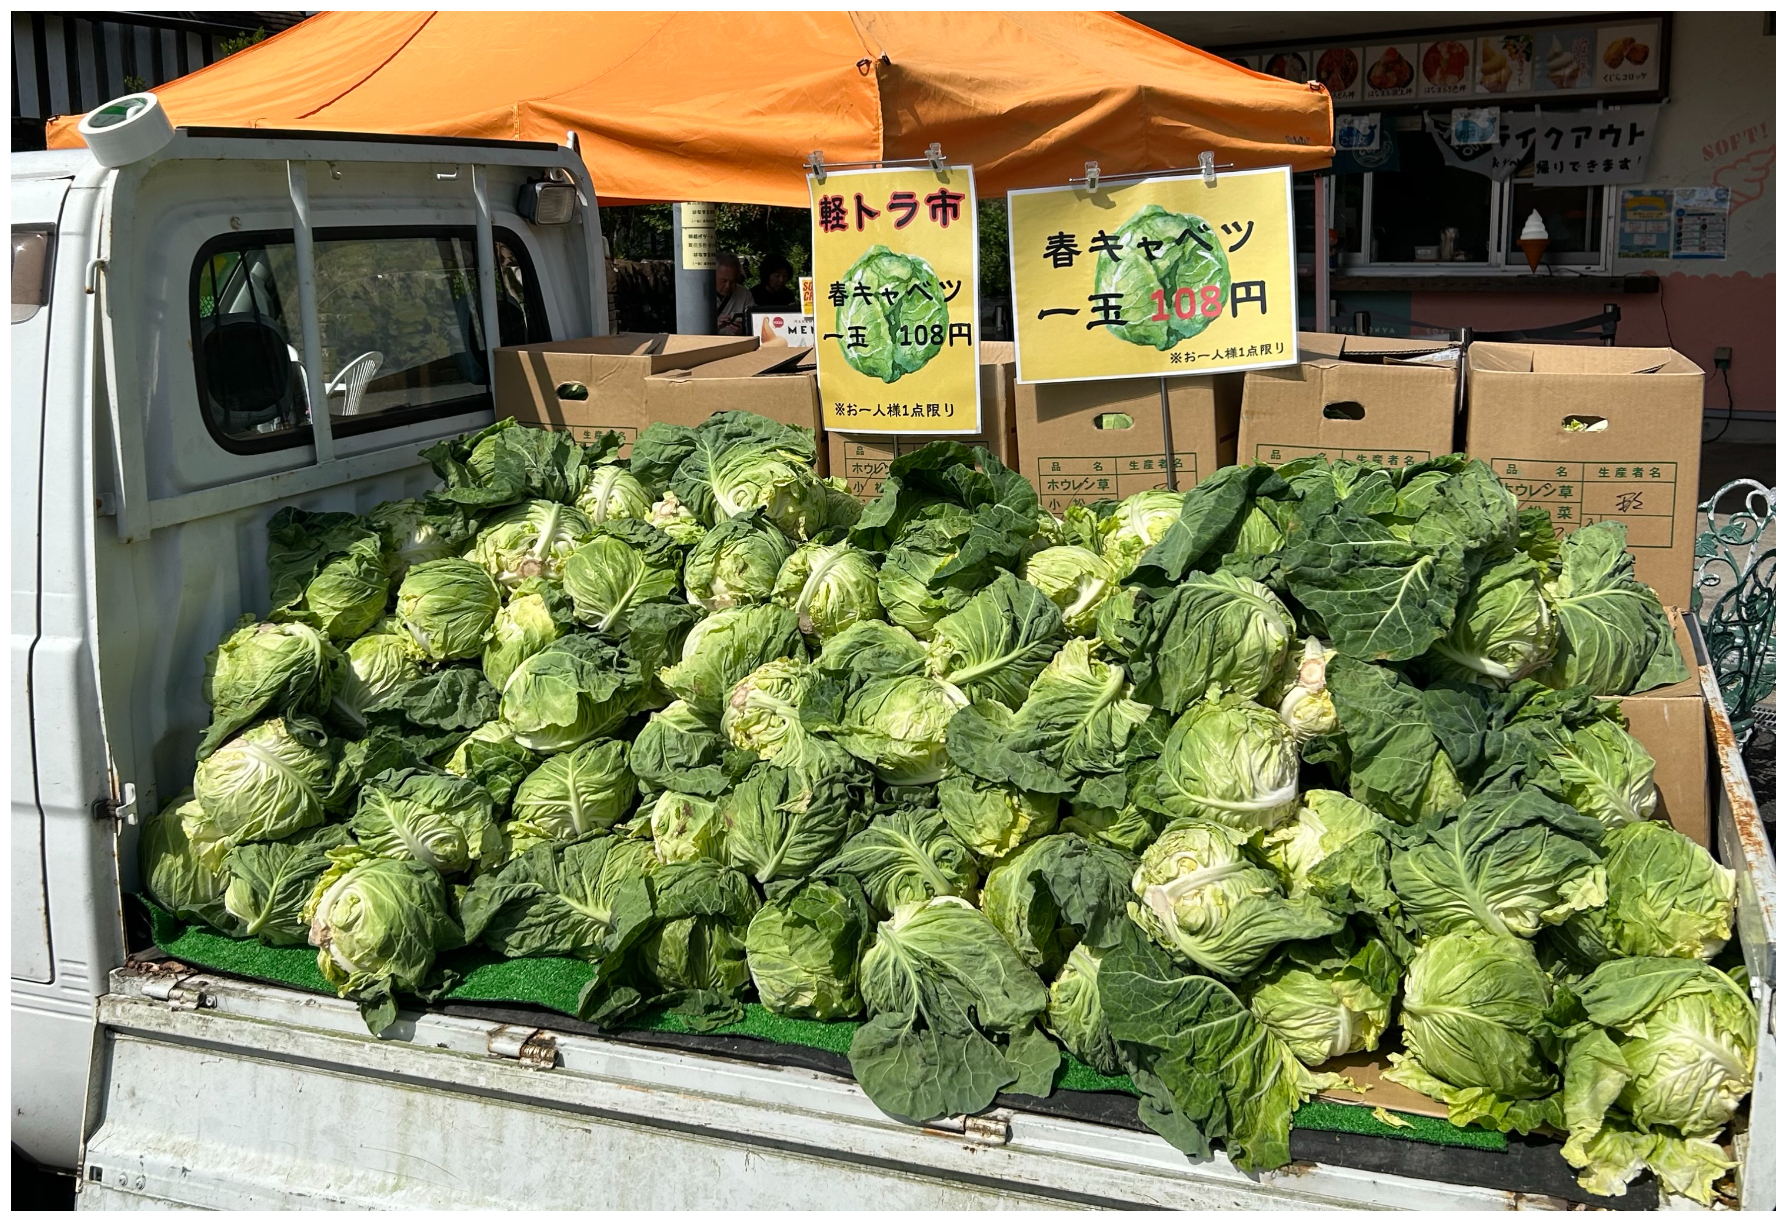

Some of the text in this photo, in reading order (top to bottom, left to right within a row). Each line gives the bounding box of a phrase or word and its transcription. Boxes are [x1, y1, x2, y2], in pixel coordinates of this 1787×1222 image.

[1603, 71, 1647, 83] くじらコロッケ
[1702, 122, 1768, 162] SOFT!
[818, 187, 966, 233] 軽トラ市
[1042, 220, 1255, 269] 春キャベツ
[828, 279, 962, 307] 春キャベツ
[1037, 279, 1267, 331] 一玉 108円
[823, 322, 972, 349] 一玉 108円
[1170, 342, 1284, 365] ※お一人様1点限り
[834, 402, 955, 418] ※お一人様1点限り
[1128, 457, 1185, 471] 生産者名
[1597, 467, 1661, 479] 生産者名
[1046, 478, 1110, 492] ホウレン草
